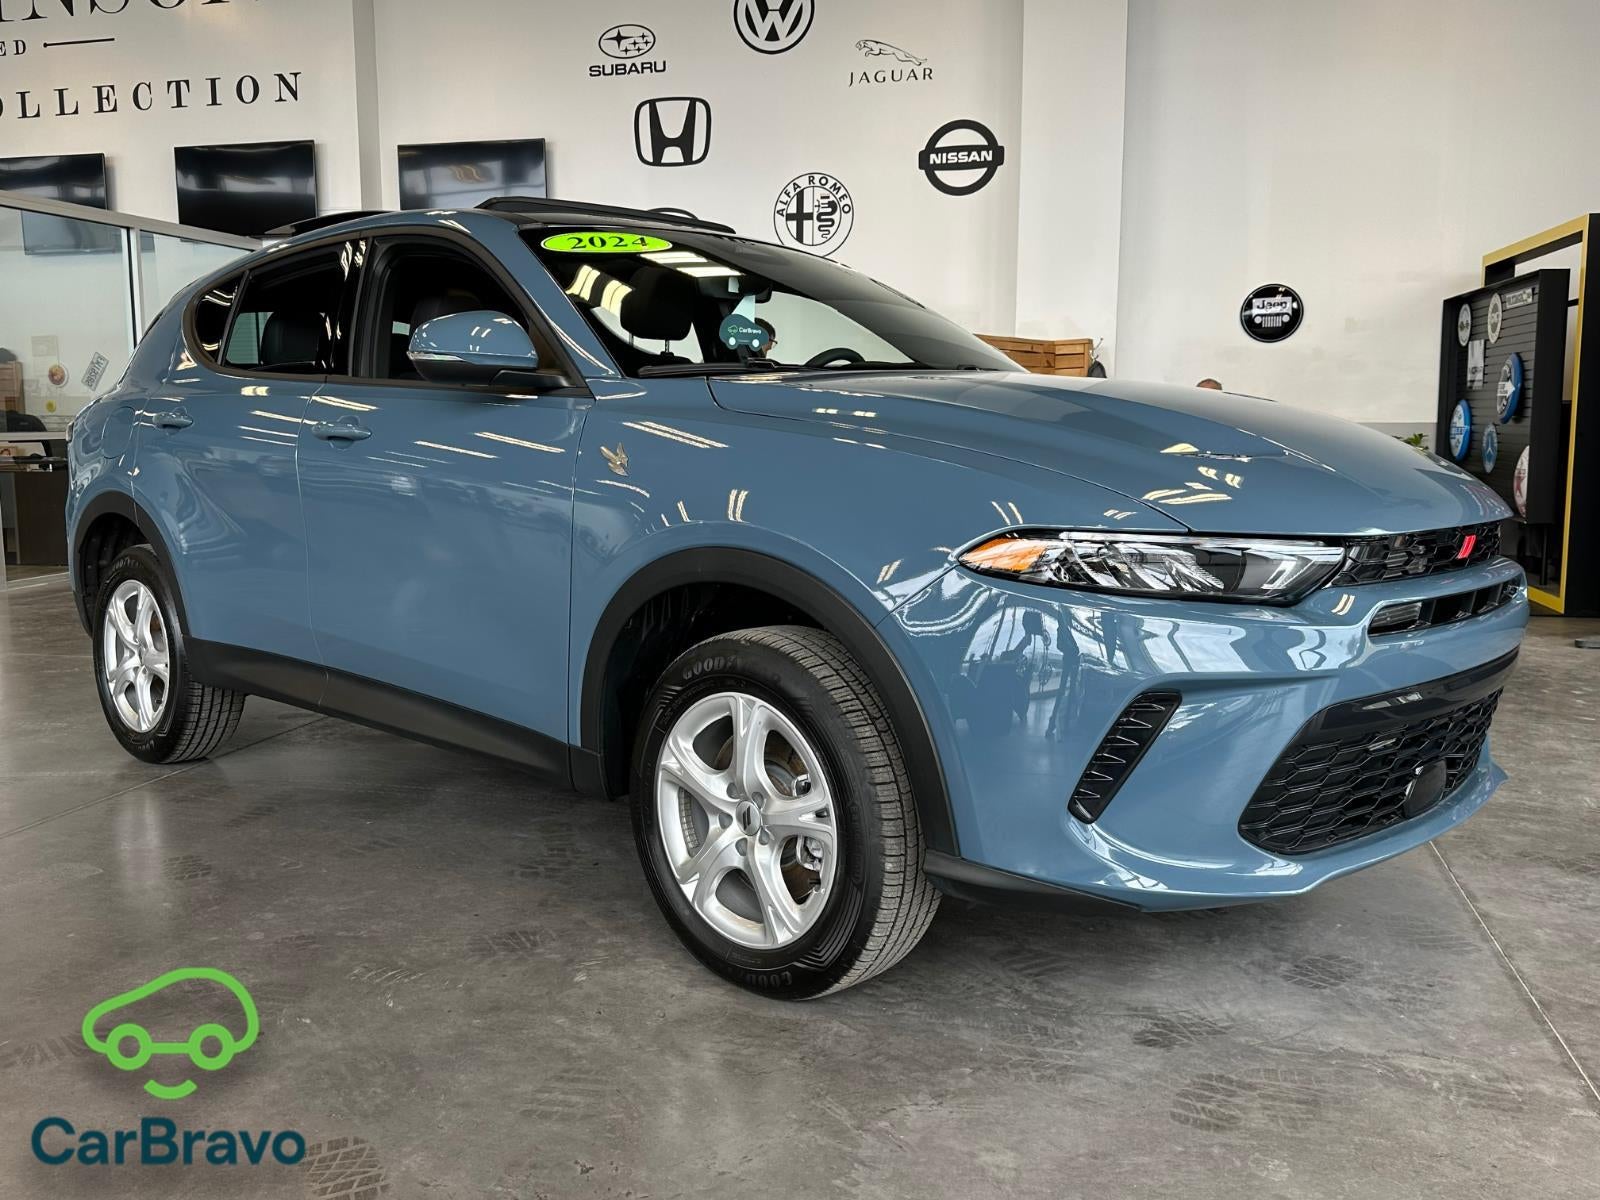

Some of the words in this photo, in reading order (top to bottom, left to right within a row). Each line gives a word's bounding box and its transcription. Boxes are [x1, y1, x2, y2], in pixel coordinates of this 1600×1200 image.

[589, 60, 666, 77] SUBARU
[849, 67, 933, 88] JAGUAR
[0, 72, 301, 119] LLECTION
[929, 150, 993, 165] NISSAN
[776, 182, 801, 217] ALFA
[808, 175, 851, 214] ROMEO
[567, 236, 648, 249] 2024
[1256, 300, 1288, 311] Jeep
